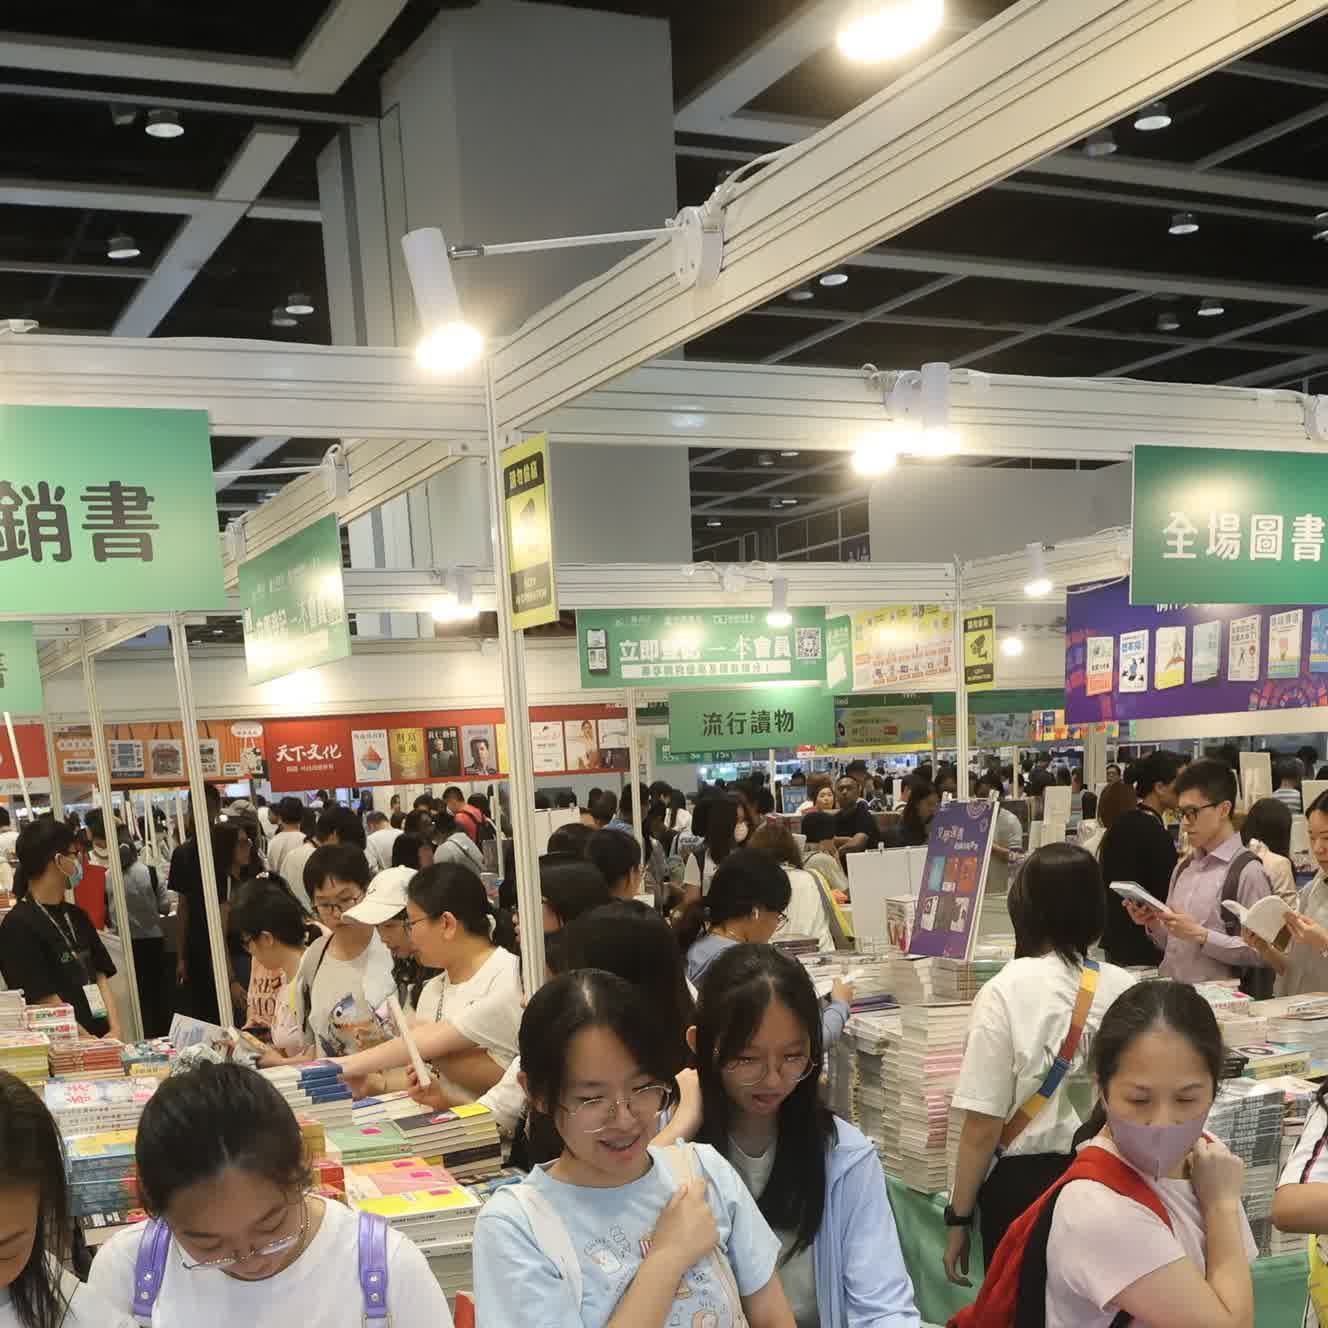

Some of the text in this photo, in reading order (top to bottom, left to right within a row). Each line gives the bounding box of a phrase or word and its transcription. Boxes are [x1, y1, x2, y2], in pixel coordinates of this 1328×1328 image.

[703, 709, 795, 738] 流行讀物
[276, 743, 343, 763] 天下文化
